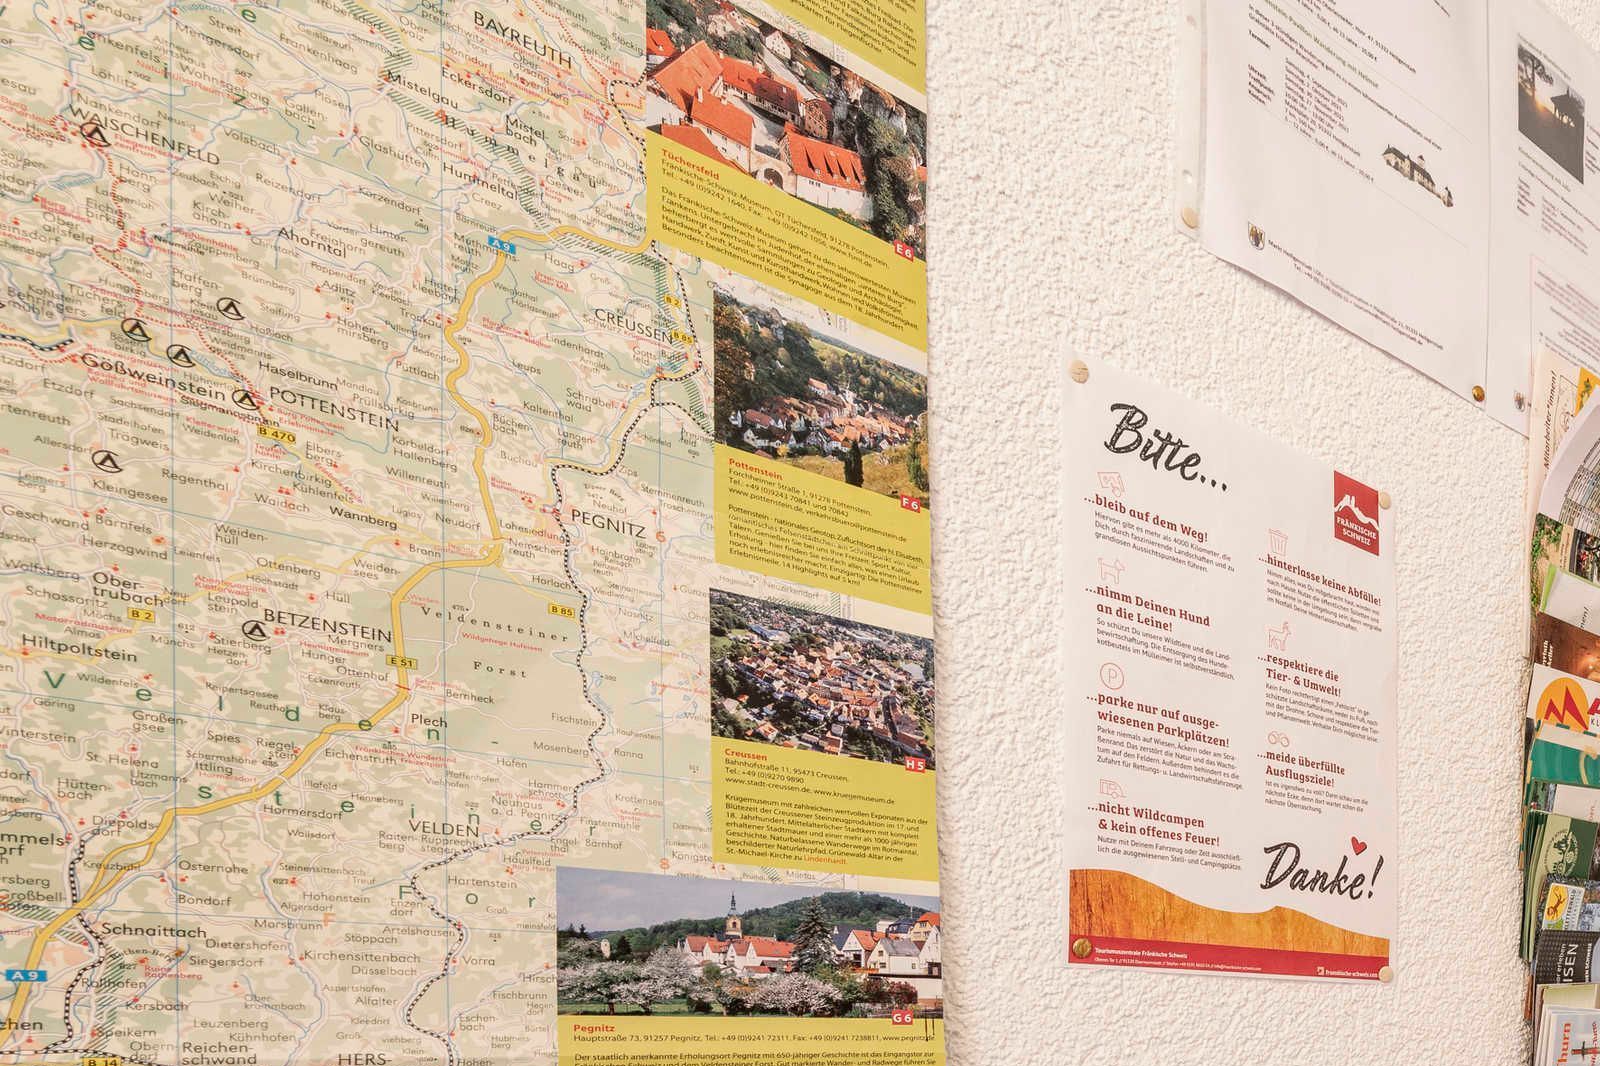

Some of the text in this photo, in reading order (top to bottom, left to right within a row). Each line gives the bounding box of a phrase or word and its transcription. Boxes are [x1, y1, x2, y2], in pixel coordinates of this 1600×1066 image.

[472, 11, 572, 69] BAYREUTH
[386, 69, 459, 111] Mistelgau
[69, 104, 220, 166] WAISCHENFELD
[661, 148, 719, 181] Tüchersfeld
[278, 226, 346, 259] Ahorntal
[594, 307, 673, 346] CREUSSEN
[80, 352, 226, 402] Gößweinstein
[269, 386, 400, 434] POTTENSTEIN
[1104, 403, 1227, 491] Bitte...
[729, 458, 782, 480] Pottenstein
[571, 508, 647, 541] PEGNITZ
[1084, 494, 1208, 543] ...bleib auf dem Weg!
[1336, 516, 1377, 540] FRÄNKISCHE
[1342, 528, 1371, 546] SCHWEIZ
[1259, 554, 1381, 606] ...hinterlasse keine Abfälle!
[1085, 584, 1210, 627] ...nimm Deinen Hund
[1096, 603, 1173, 631] an die Leine!
[264, 608, 392, 644] BETZENSTEIN
[22, 634, 138, 664] Hiltpoltstein
[1267, 668, 1341, 698] Tier- & Umwelt!
[1325, 668, 1339, 682] die
[410, 712, 448, 729] Plech
[1087, 692, 1219, 730] ...parke nur auf ausge-
[1097, 711, 1229, 748] wiesenen Parkplätzen!
[725, 748, 768, 761] Creussen
[1299, 753, 1345, 775] überfüllte
[1266, 766, 1334, 787] Ausflugsziele!
[408, 819, 480, 840] VELDEN
[1088, 802, 1205, 828] ...nicht Wildcampen
[1099, 819, 1219, 846] & kein offenes Feuer!
[1260, 842, 1384, 900] Danke!
[102, 922, 207, 939] Schnaittach
[573, 1023, 616, 1033] Pegnitz
[338, 1051, 393, 1066] HERS-
